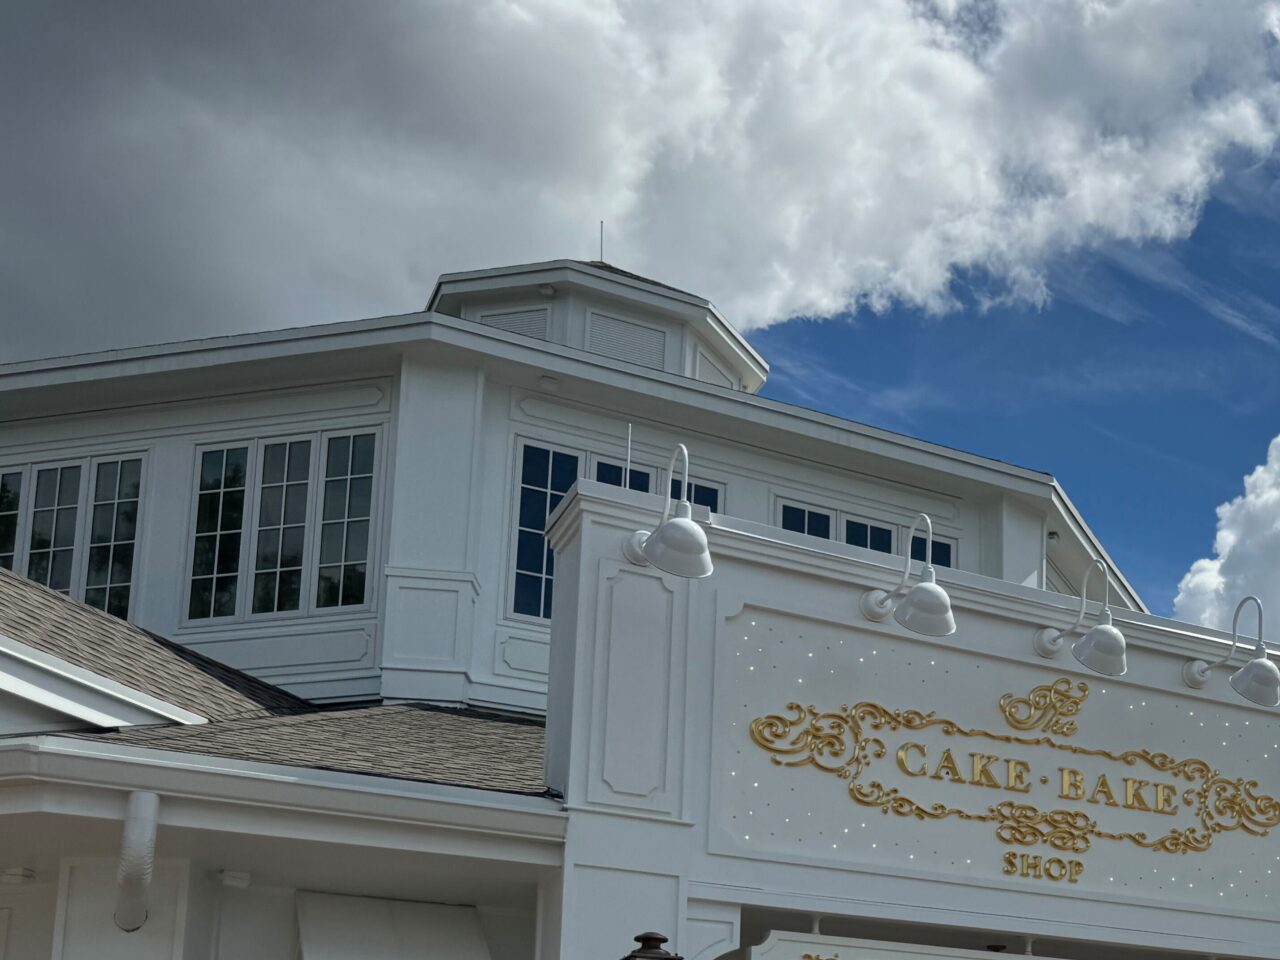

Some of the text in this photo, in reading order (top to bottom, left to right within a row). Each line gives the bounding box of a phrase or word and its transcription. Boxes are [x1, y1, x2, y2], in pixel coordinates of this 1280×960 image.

[998, 677, 1090, 738] The
[896, 742, 1180, 817] CAKE BAKE
[1002, 850, 1085, 885] SHOP
